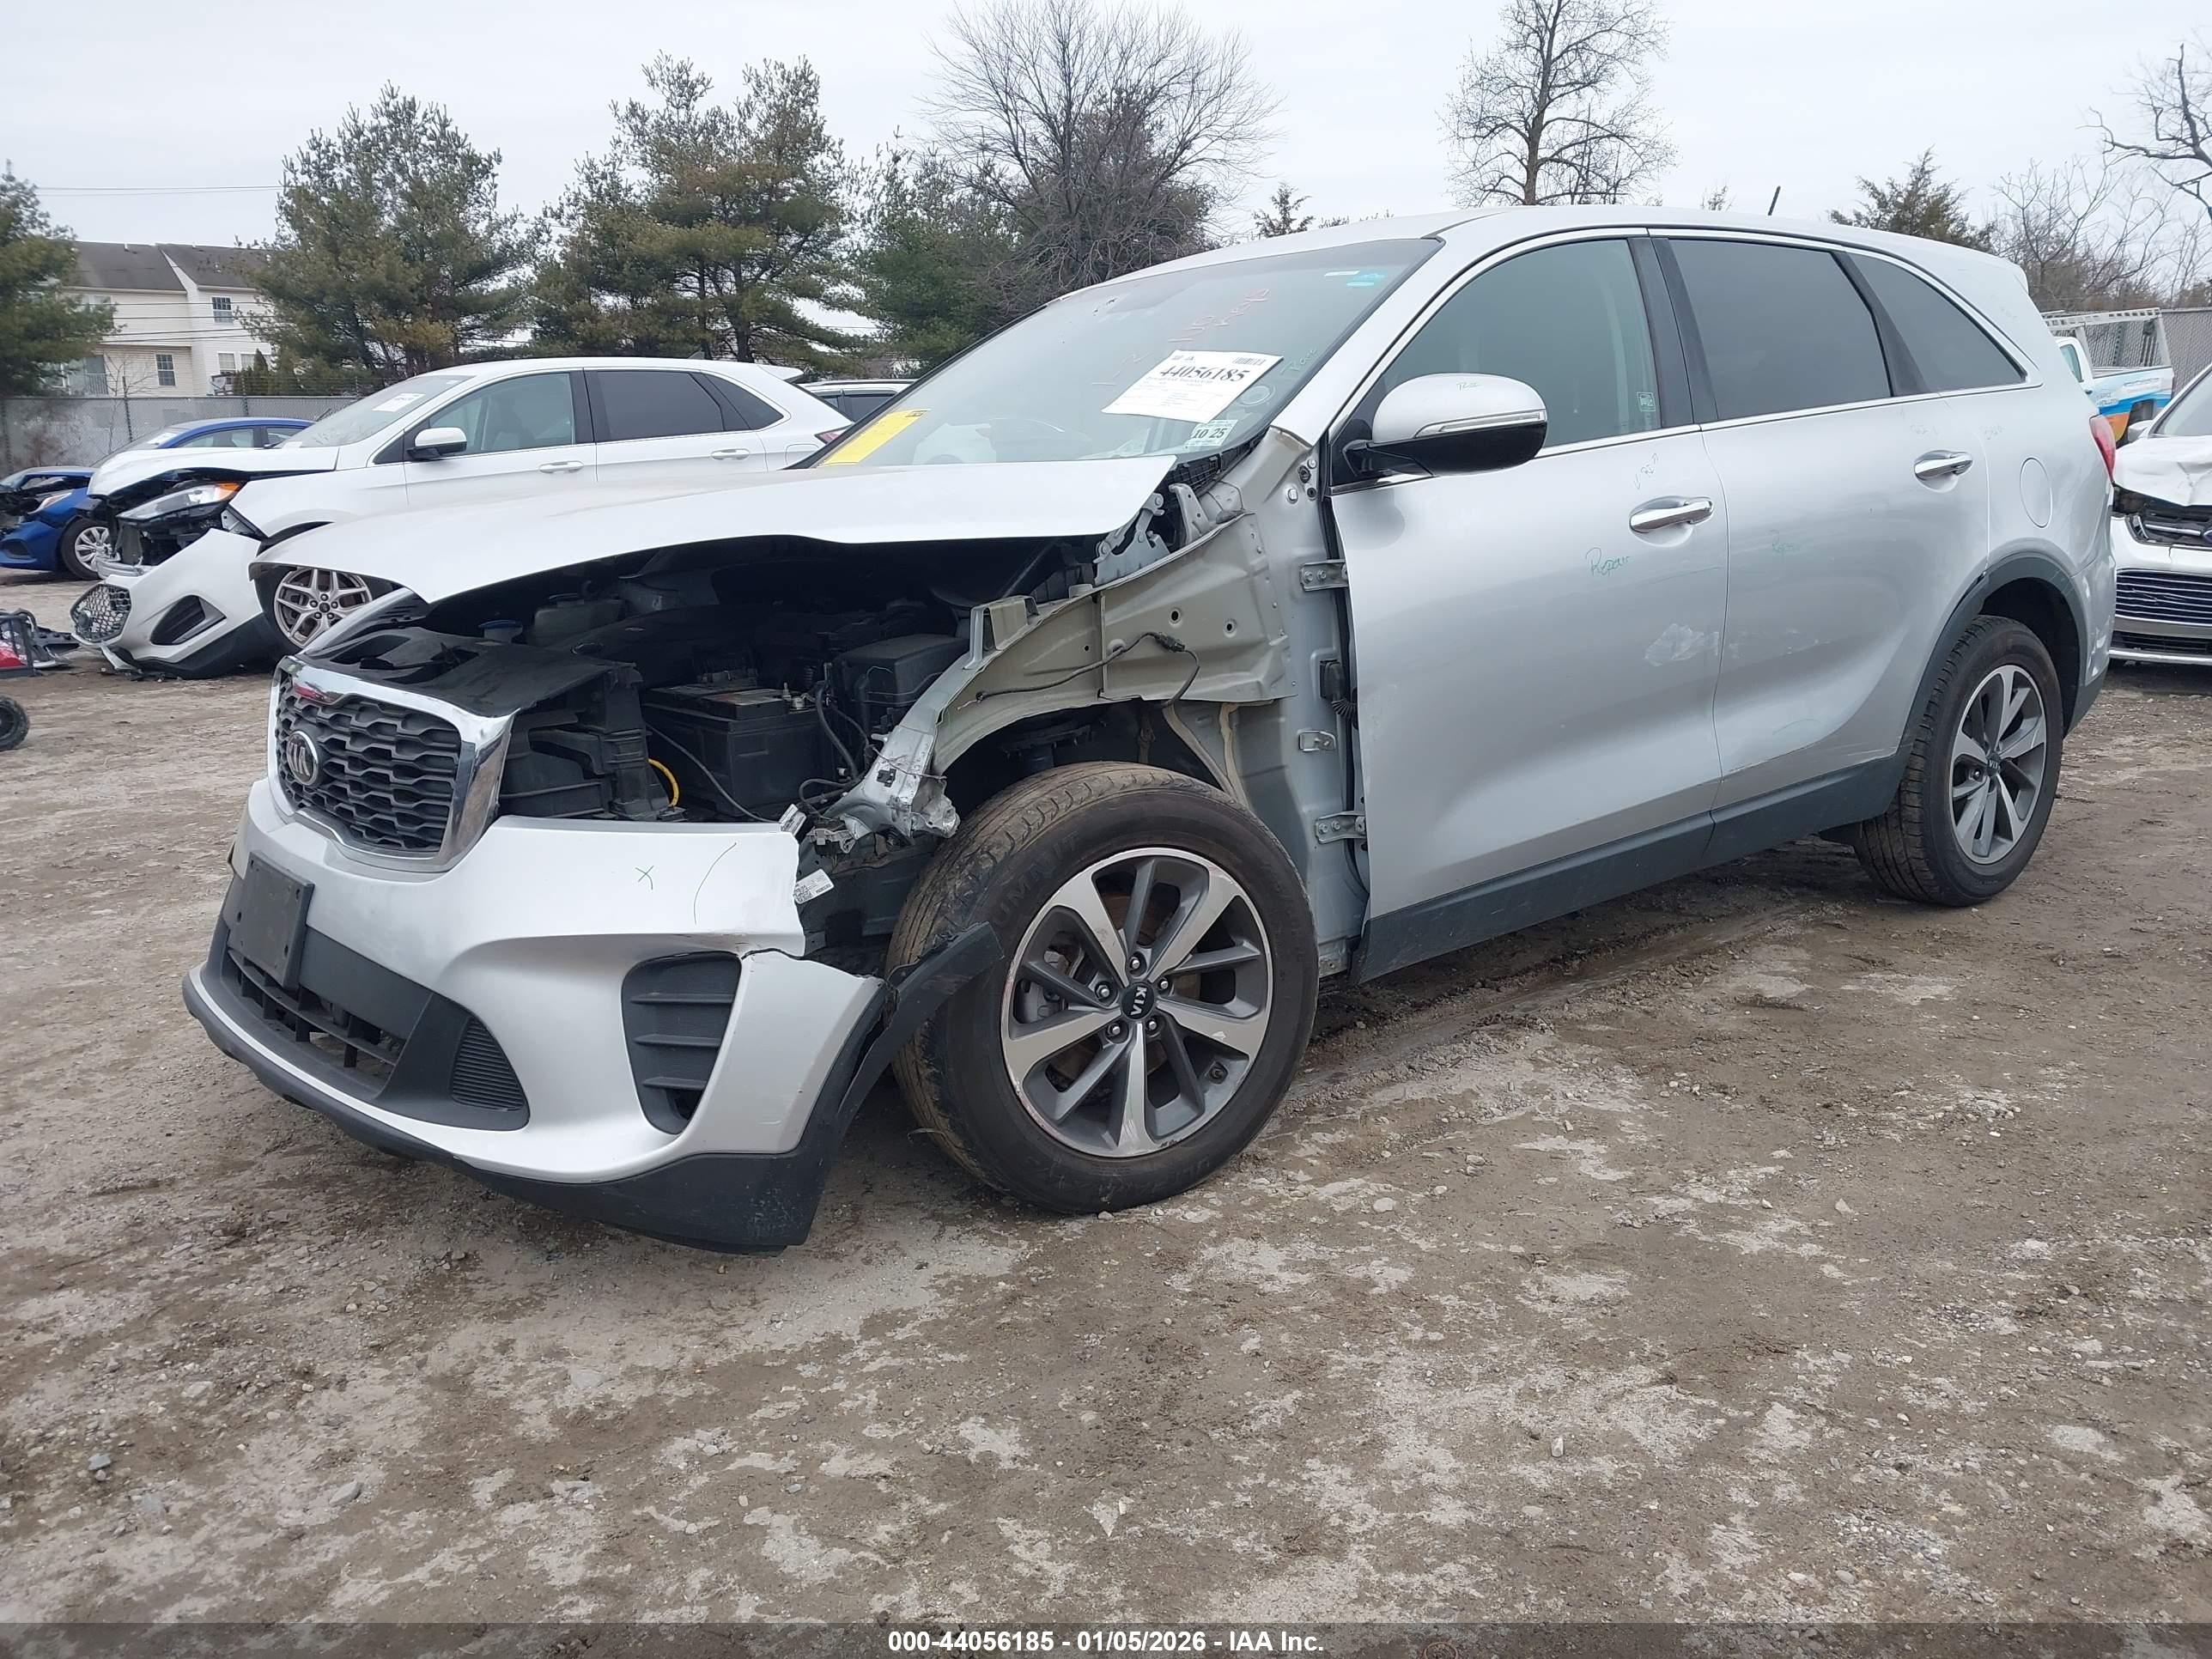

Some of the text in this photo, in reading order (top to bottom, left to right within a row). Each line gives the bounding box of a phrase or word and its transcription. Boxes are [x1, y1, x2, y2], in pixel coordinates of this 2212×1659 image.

[1159, 365, 1251, 383] 44056185
[1191, 428, 1228, 439] 10 25
[1585, 547, 1630, 577] Repair
[1130, 987, 1147, 1015] KIA
